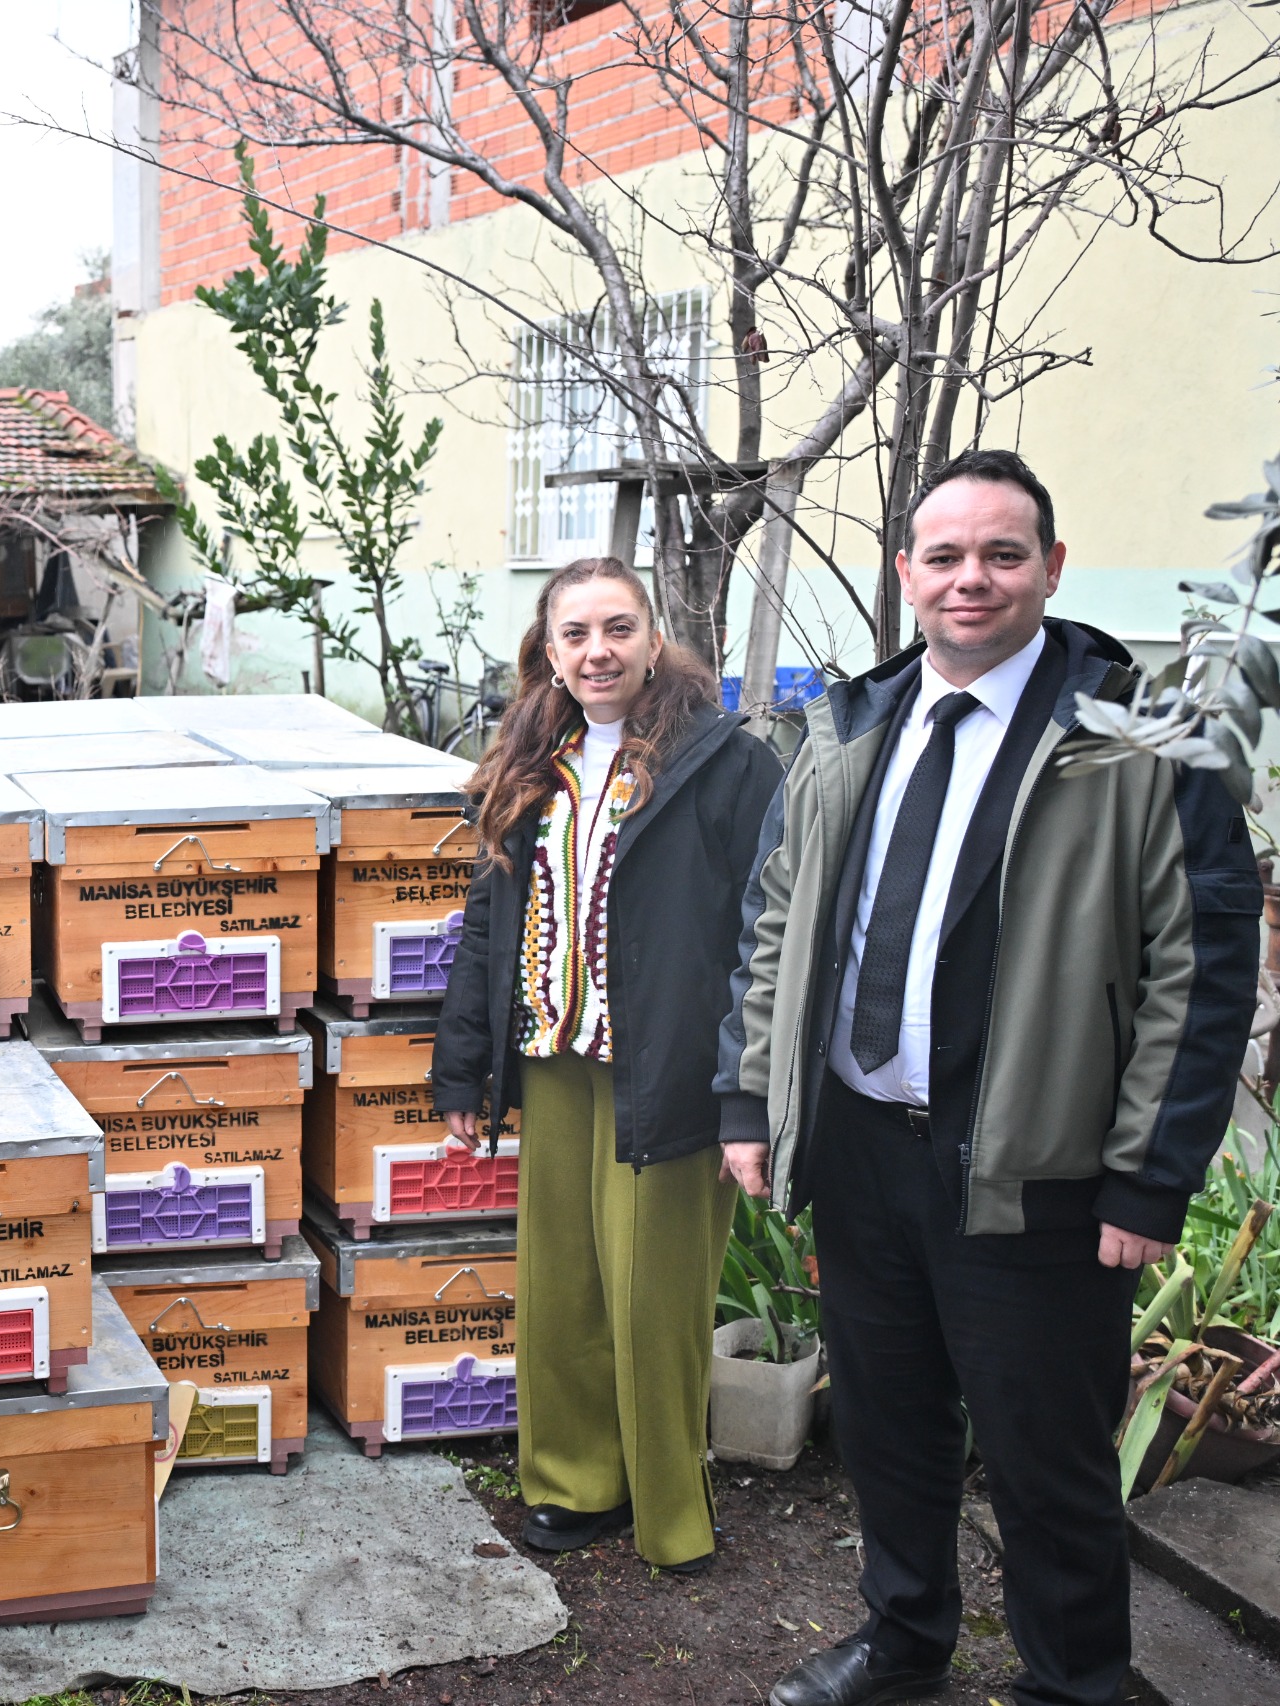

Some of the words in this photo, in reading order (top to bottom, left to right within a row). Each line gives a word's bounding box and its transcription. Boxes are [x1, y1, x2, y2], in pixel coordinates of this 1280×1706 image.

[353, 864, 421, 882] MANİSA
[80, 881, 152, 901] MANİSA
[157, 875, 277, 898] BÜYÜKŞEHİR
[396, 882, 471, 901] BELEDİY
[125, 897, 232, 919] BELEDİYESİ
[220, 915, 301, 931] SATILAMAZ
[353, 1089, 419, 1107] MANİSA
[95, 1115, 136, 1133] NİSA
[204, 1149, 284, 1164] SATILAMAZ
[365, 1309, 430, 1329] MANİSA
[152, 1330, 268, 1352] BÜYÜKŞEHİR
[405, 1322, 504, 1345] BELEDİYESİ
[157, 1351, 225, 1370] EDİYESİ
[214, 1369, 290, 1383] SATILAMAZ
